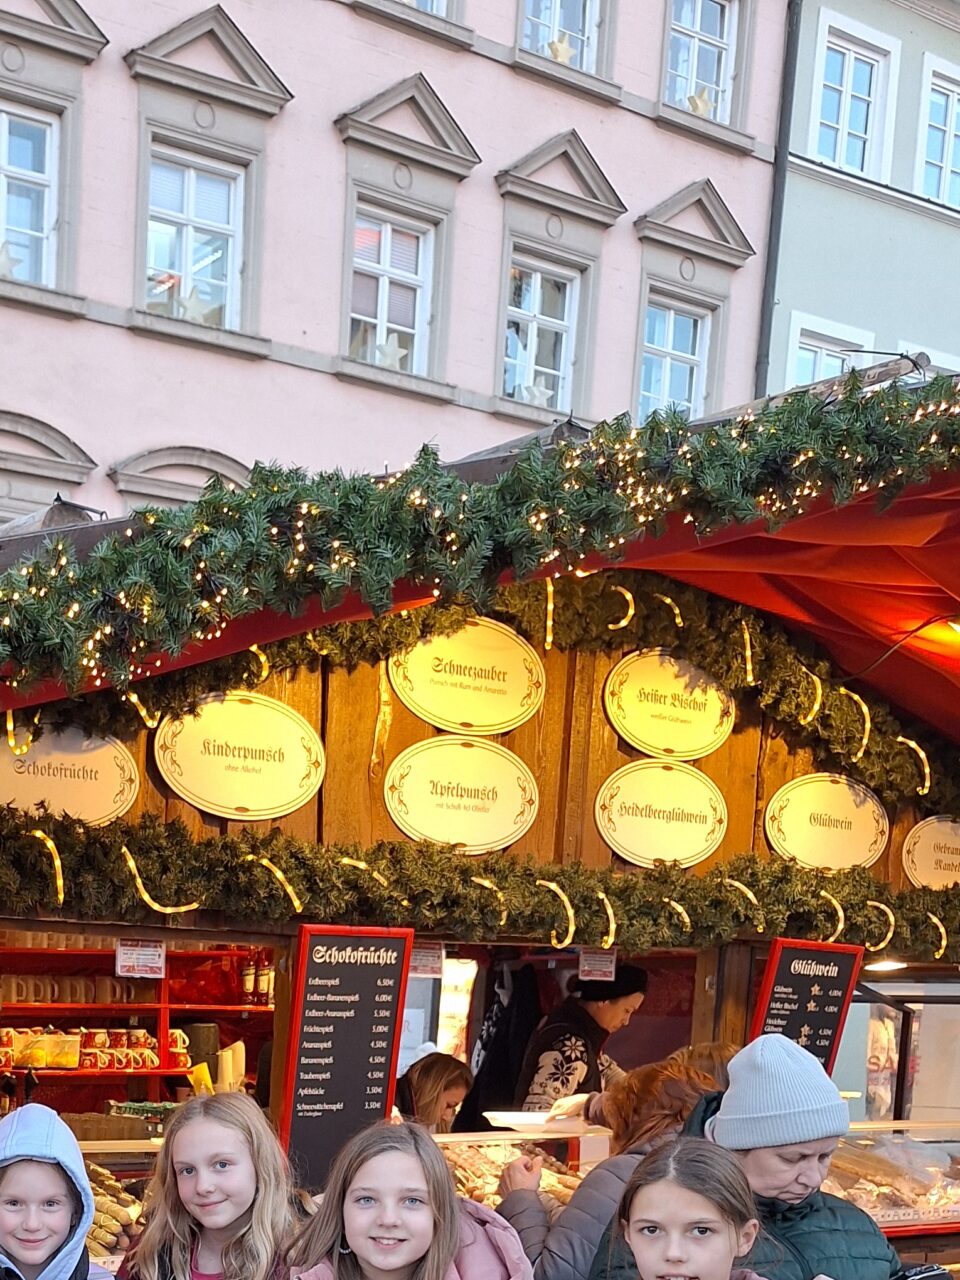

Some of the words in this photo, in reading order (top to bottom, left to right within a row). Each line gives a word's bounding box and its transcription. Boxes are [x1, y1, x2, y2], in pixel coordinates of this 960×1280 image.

[431, 656, 507, 682] Schneezauber
[637, 688, 668, 706] Heißer
[670, 693, 708, 712] Bischof
[200, 739, 285, 764] Kinderpunsch
[13, 758, 100, 781] Schokofrüchte
[429, 779, 498, 803] Apfelpunsch
[617, 802, 708, 825] Heidelbeerglühwein
[809, 812, 853, 831] Glühwein
[312, 945, 398, 967] Schokofrüchte
[790, 959, 839, 977] Glühwein
